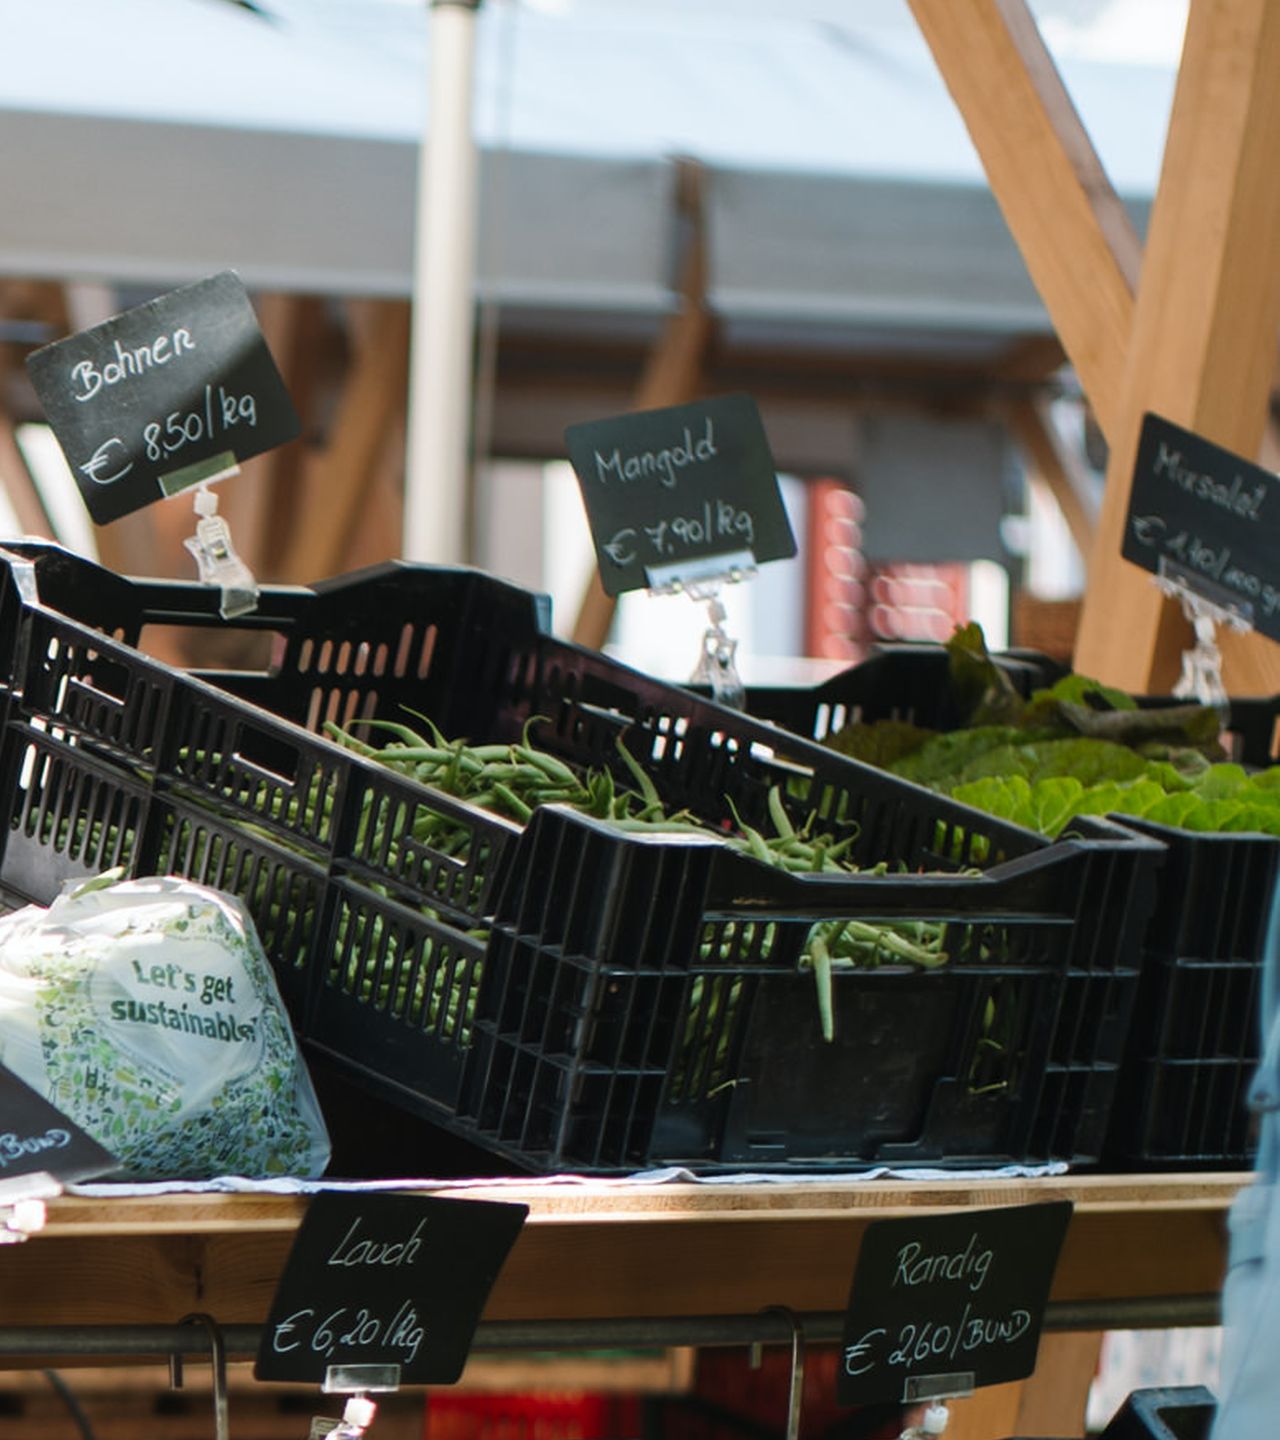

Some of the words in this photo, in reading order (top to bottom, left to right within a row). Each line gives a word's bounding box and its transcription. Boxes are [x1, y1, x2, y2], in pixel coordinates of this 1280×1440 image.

[80, 438, 134, 484] €
[594, 416, 718, 488] Mangold
[602, 528, 637, 566] €
[200, 974, 237, 1006] get
[327, 1216, 429, 1267] Lauch
[891, 1232, 994, 1292] Randig
[272, 1308, 315, 1353] €
[845, 1327, 886, 1376] €
